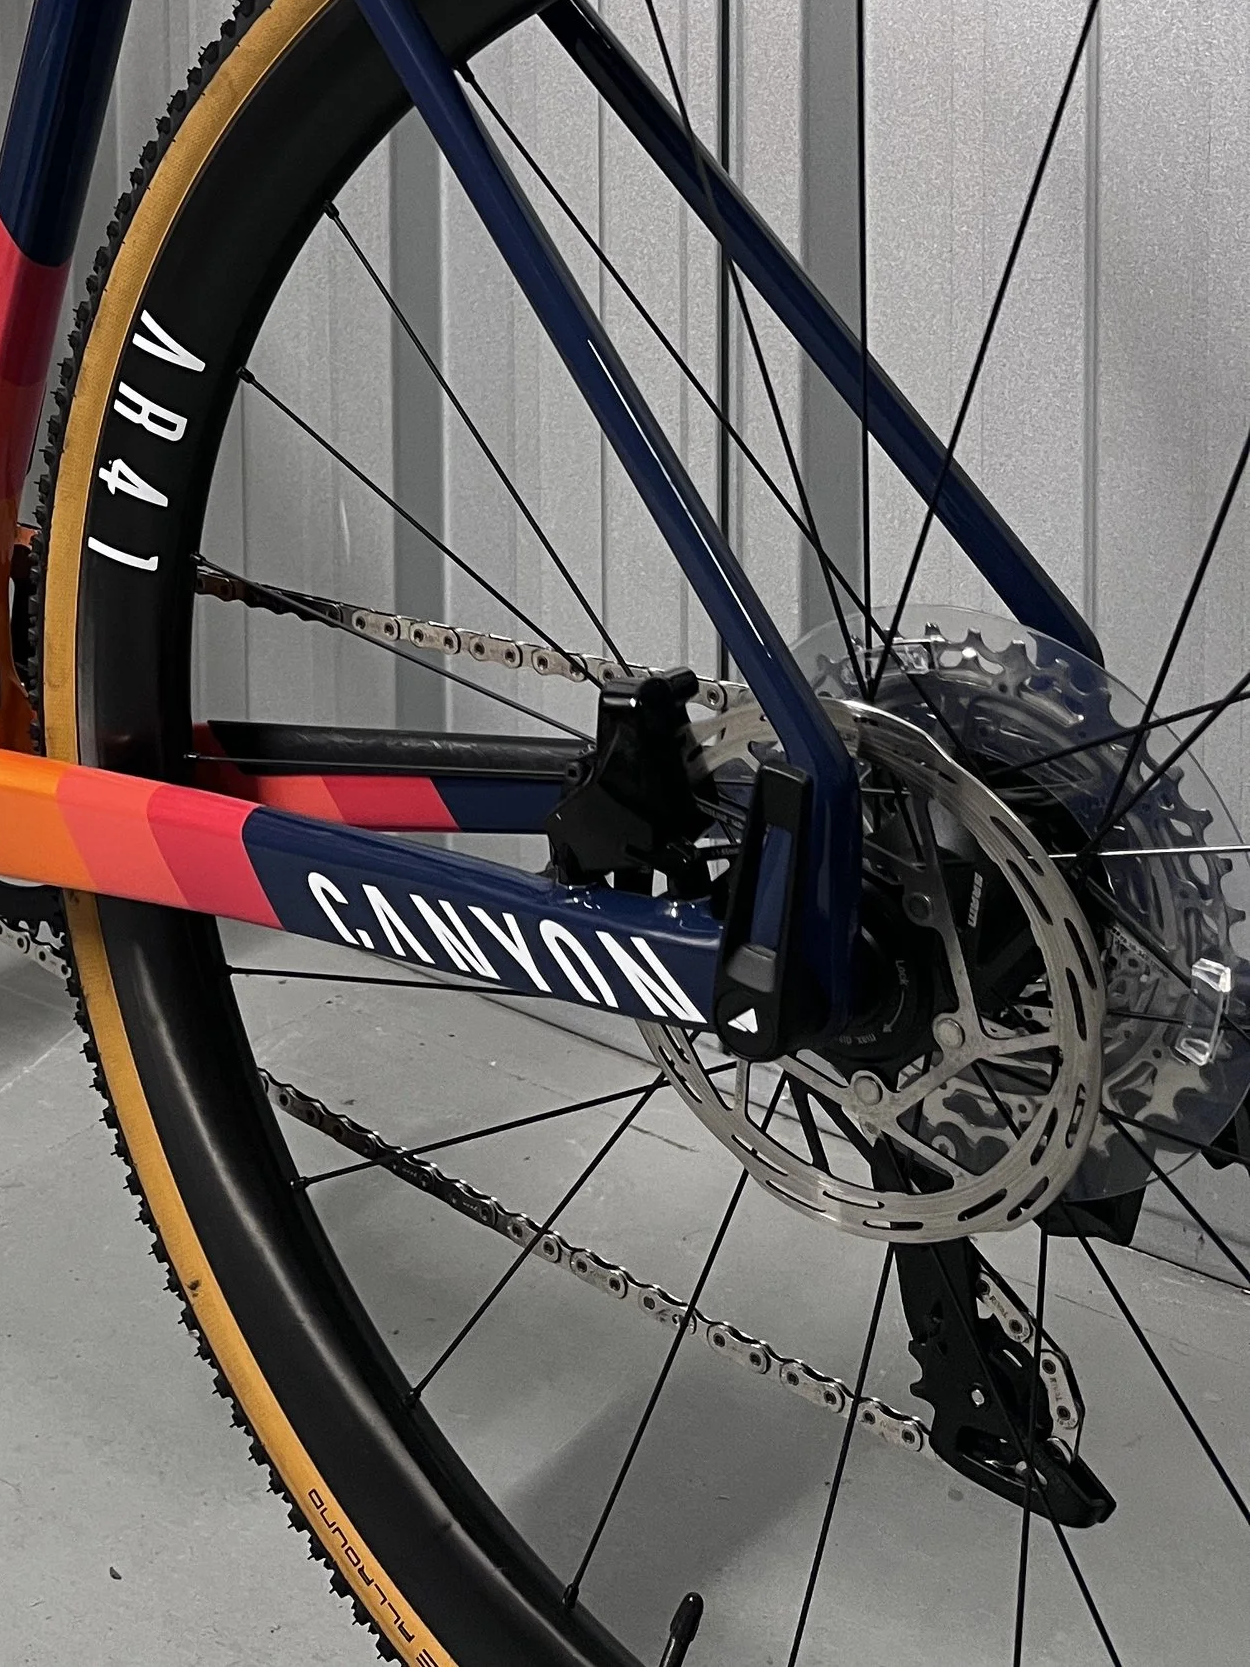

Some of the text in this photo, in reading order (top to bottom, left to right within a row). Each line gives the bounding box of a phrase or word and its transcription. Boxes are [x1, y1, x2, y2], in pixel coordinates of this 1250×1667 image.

[88, 309, 206, 572] AR41
[307, 871, 708, 1024] CANYON
[308, 1488, 416, 1643] ALLROUND
